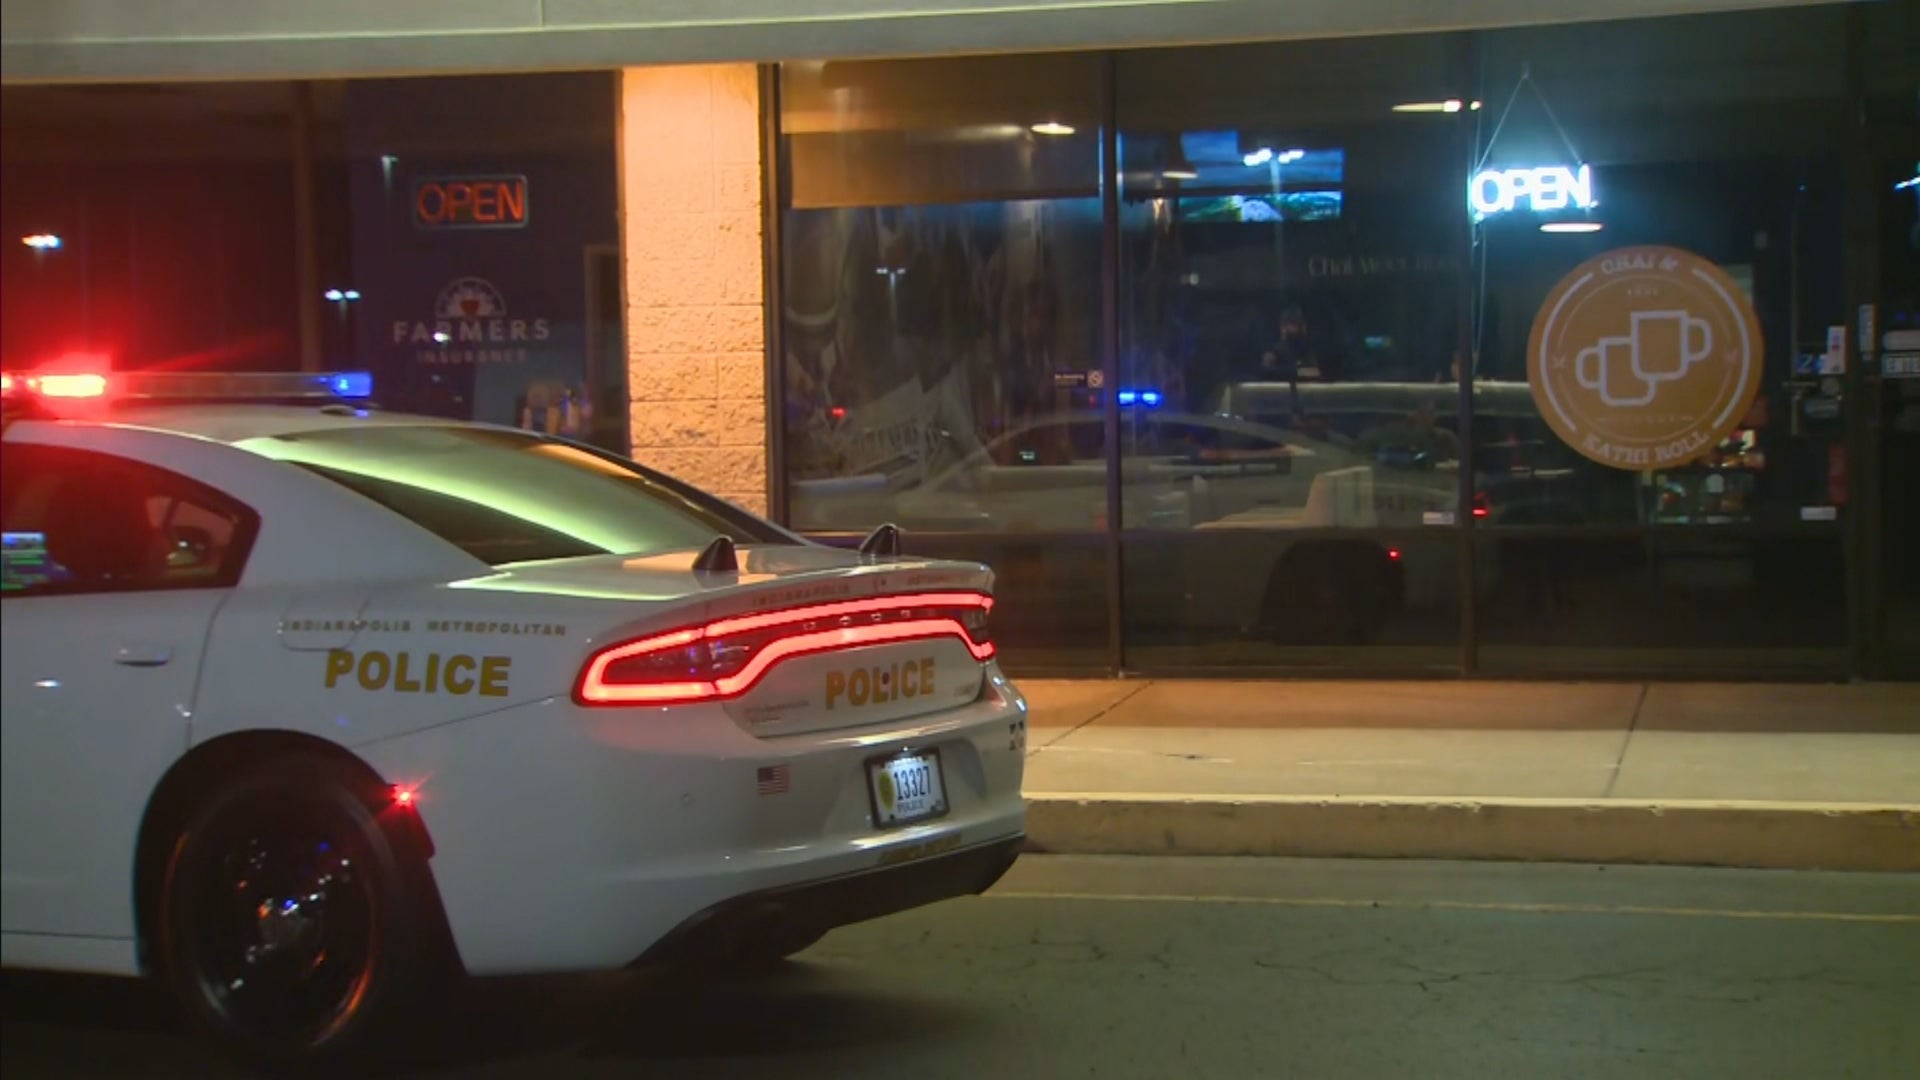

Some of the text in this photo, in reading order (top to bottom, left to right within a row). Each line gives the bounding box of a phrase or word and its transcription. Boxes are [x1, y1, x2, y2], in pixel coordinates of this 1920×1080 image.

[417, 182, 525, 224] OPEN
[1471, 164, 1592, 212] OPEN
[1600, 253, 1657, 275] CHAI
[393, 319, 549, 343] FARMERS
[1582, 430, 1710, 465] KATHI ROLL
[284, 619, 567, 637] INDIANAPOLIS METROPOLITAN
[324, 648, 512, 697] POLICE
[826, 656, 936, 710] POLICE
[893, 765, 932, 801] 13327
